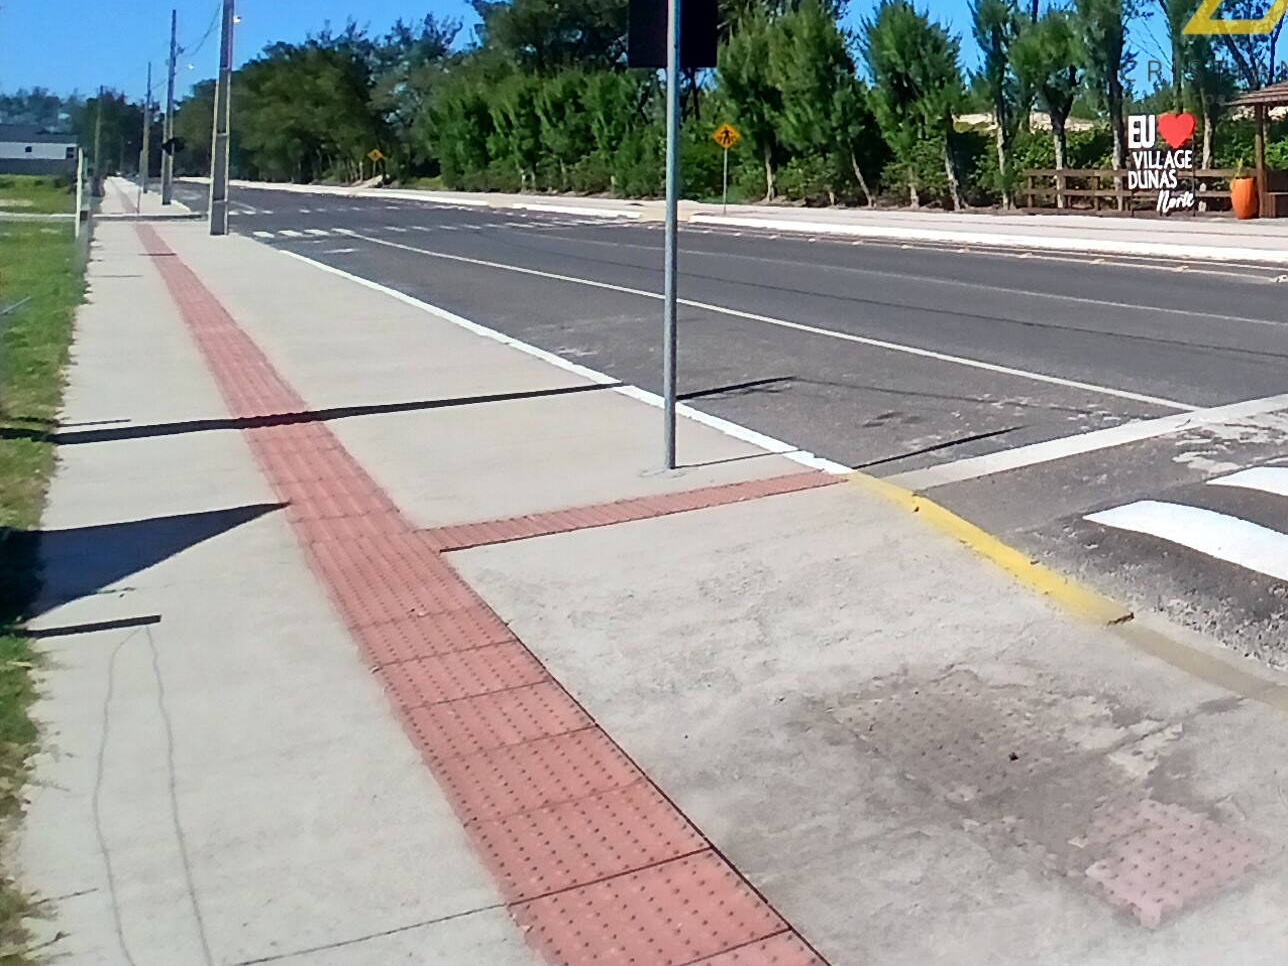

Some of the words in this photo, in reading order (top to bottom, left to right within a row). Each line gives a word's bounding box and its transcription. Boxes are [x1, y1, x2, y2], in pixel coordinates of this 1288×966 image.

[1128, 114, 1156, 149] EU
[1133, 149, 1193, 169] VILLAGE
[1128, 169, 1178, 190] DUNAS
[1156, 190, 1195, 213] Norte
